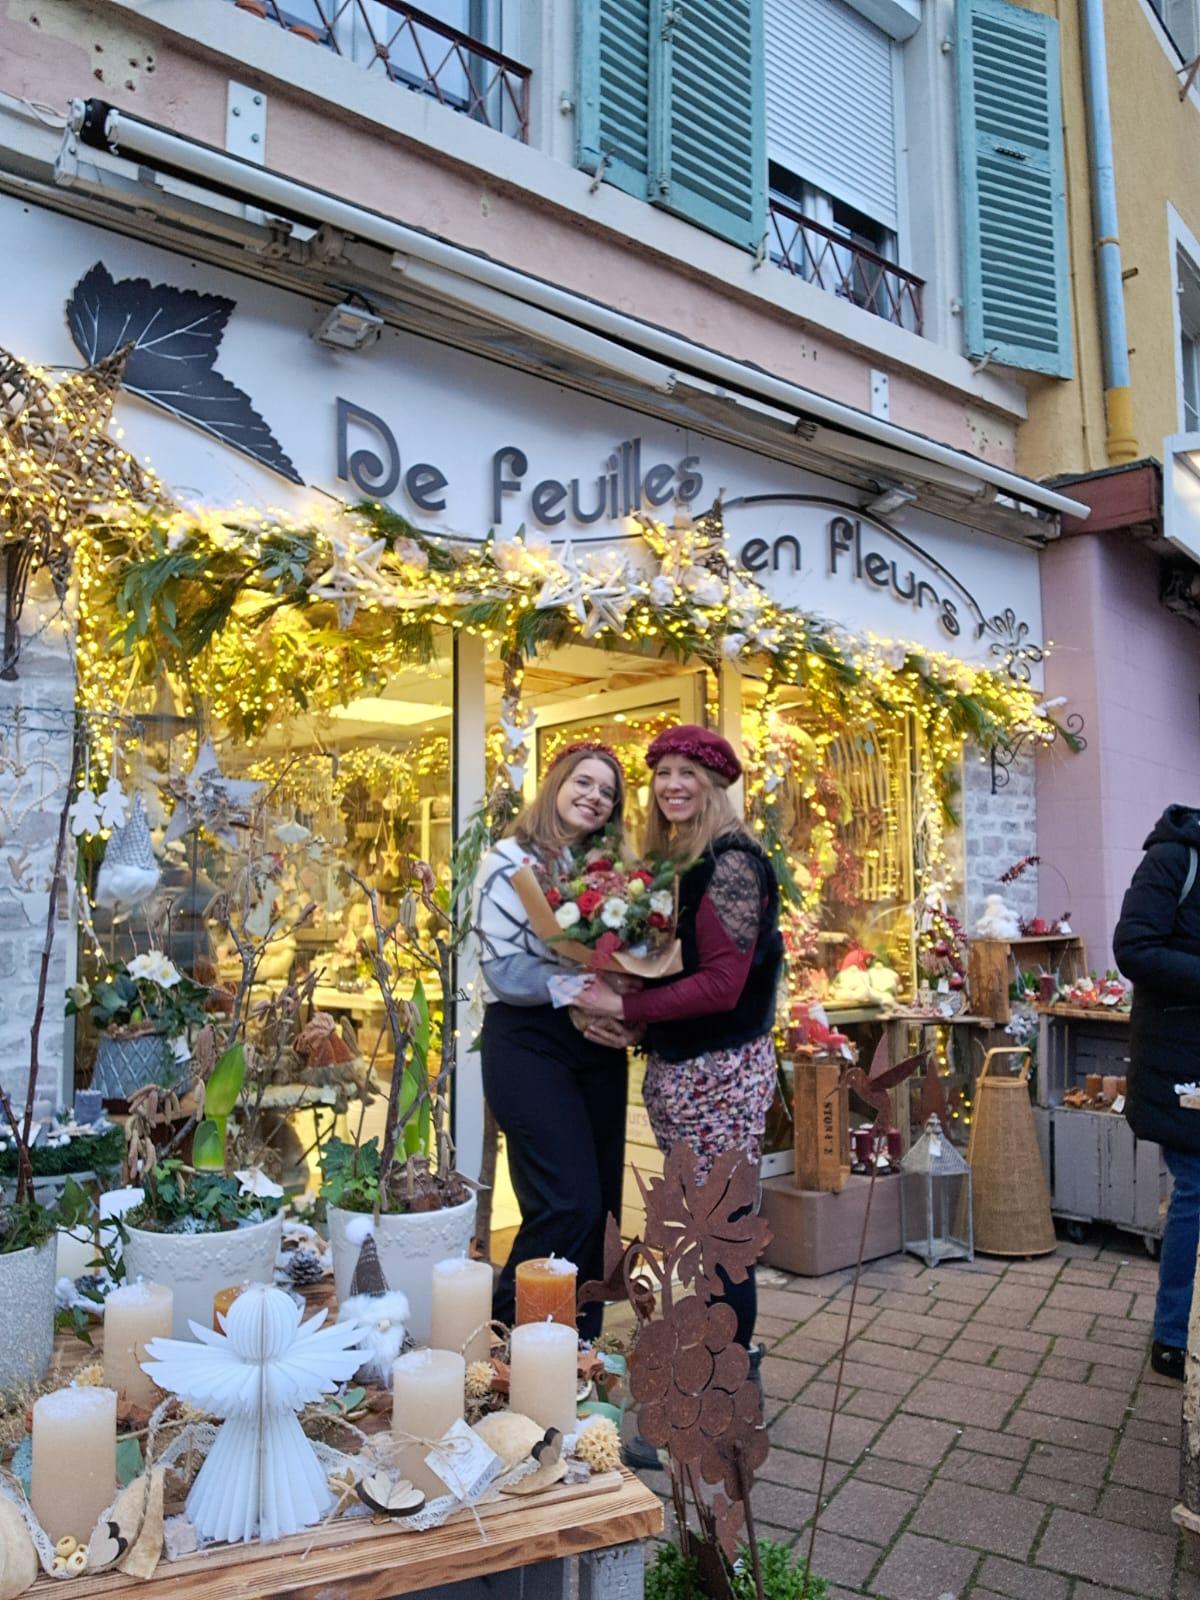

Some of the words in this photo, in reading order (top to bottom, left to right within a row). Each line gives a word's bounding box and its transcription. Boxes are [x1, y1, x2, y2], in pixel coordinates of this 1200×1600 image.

[336, 396, 449, 512] De
[492, 437, 703, 527] feuilles
[741, 533, 801, 572] en
[830, 516, 960, 637] fleurs
